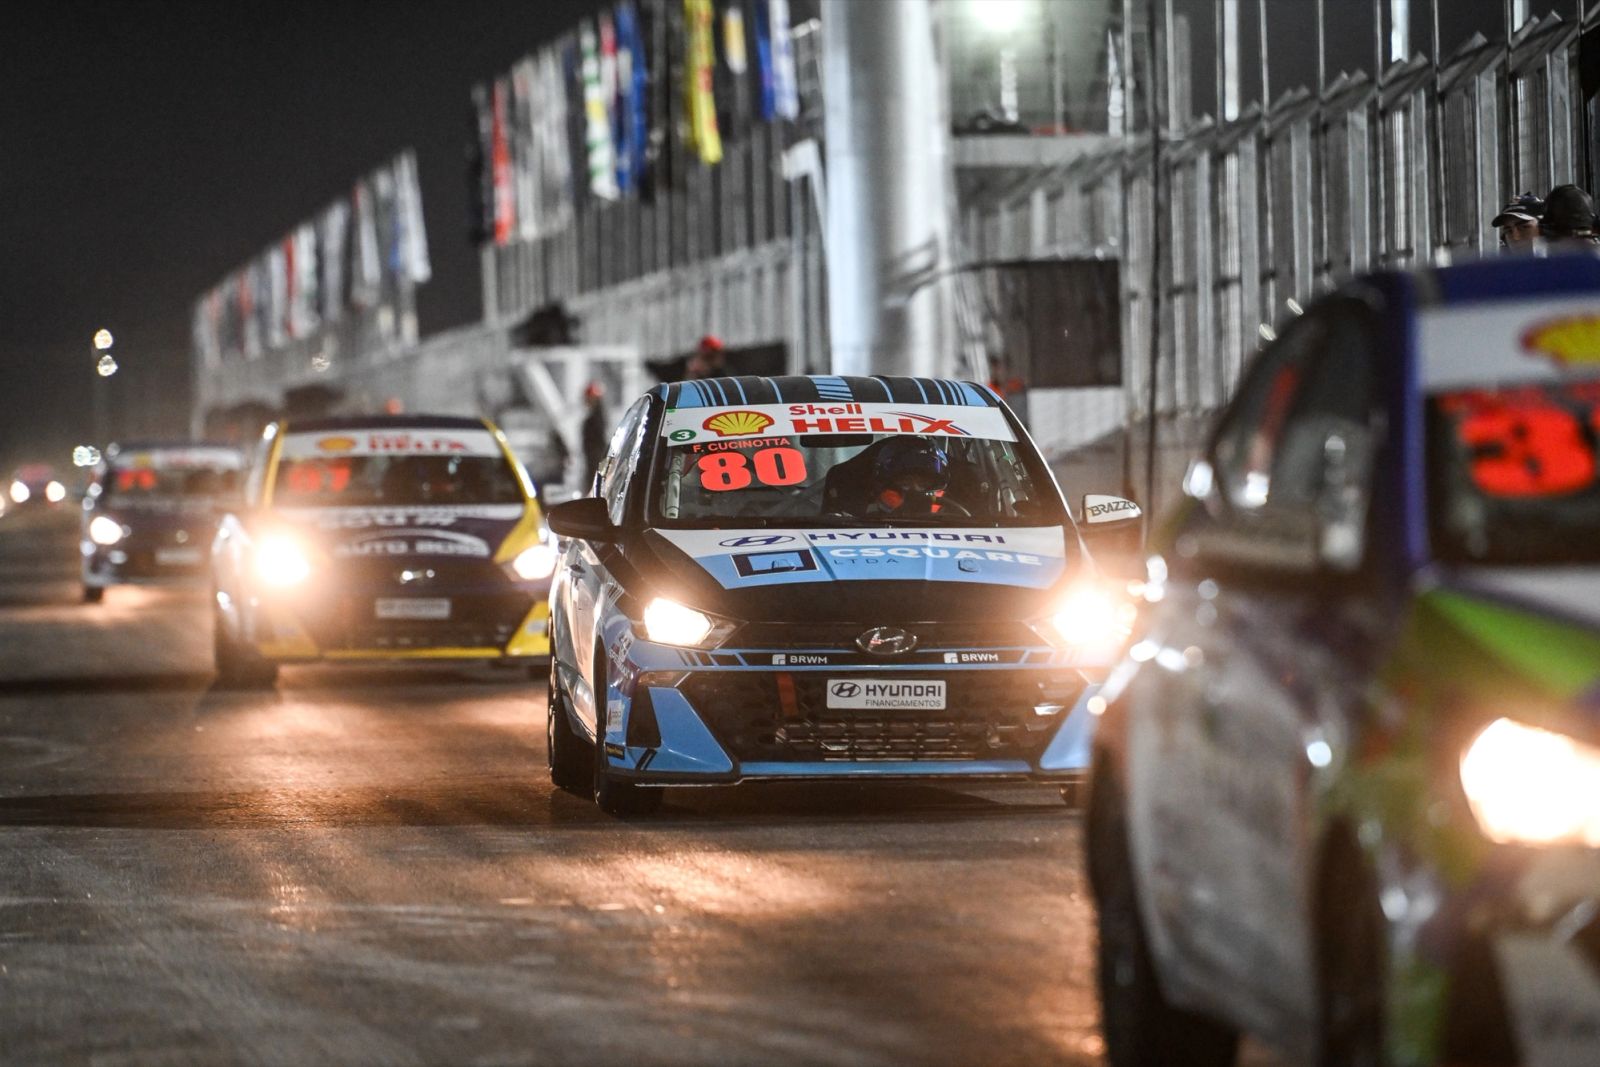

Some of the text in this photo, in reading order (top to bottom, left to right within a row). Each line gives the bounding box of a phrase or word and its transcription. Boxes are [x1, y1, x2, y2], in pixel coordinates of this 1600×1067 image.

[789, 403, 863, 415] Shell
[790, 416, 966, 435] HELIX
[676, 431, 690, 440] 3
[692, 437, 790, 453] F. CUCINOTTA
[698, 447, 807, 491] 80
[808, 532, 1006, 544] HYUNDAI
[829, 547, 1042, 566] CSQUARE
[790, 655, 827, 664] BRWM
[961, 653, 998, 662] BRWM
[866, 684, 941, 697] HYUNDAI
[865, 699, 941, 708] FINANCIAMENTOS
